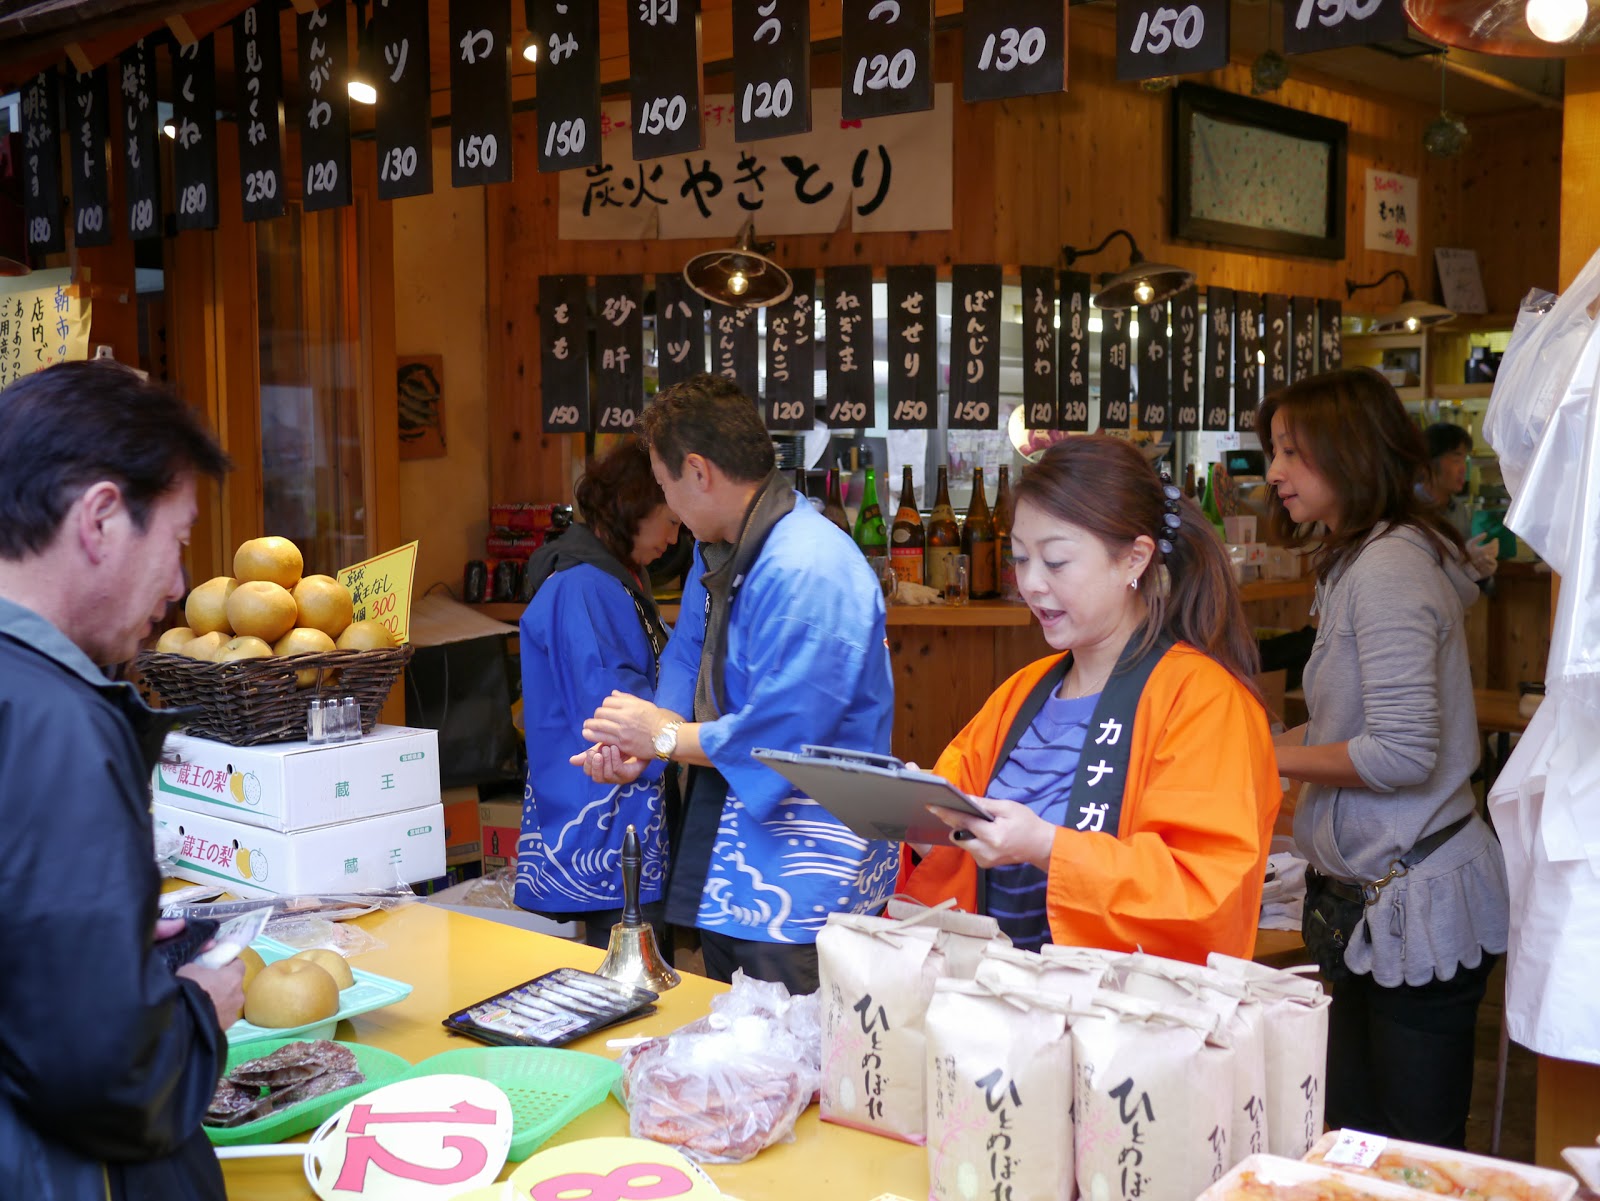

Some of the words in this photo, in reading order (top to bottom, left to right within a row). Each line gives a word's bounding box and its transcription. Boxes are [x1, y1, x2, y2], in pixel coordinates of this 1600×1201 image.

[1130, 4, 1204, 54] 150
[977, 26, 1046, 71] 130
[244, 7, 267, 146] 月見つくね
[852, 48, 916, 95] 120
[638, 95, 687, 135] 150
[741, 78, 793, 123] 120
[458, 134, 497, 168] 150
[545, 118, 586, 157] 150
[307, 160, 338, 195] 120
[381, 146, 417, 182] 130
[582, 143, 892, 218] 炭火やきとり
[180, 183, 207, 214] 180
[246, 169, 277, 203] 230
[30, 217, 51, 243] 180
[78, 205, 103, 234] 100
[131, 199, 153, 231] 180
[31, 296, 48, 362] 店内で
[553, 303, 569, 360] もも
[602, 294, 637, 374] 砂肝
[665, 301, 692, 363] ハツ
[836, 291, 861, 372] ねぎま
[901, 292, 924, 378] せせり
[964, 290, 994, 384] ぼんじり
[1034, 287, 1052, 376] えんがわ
[1069, 292, 1084, 387] 月見つくね
[719, 315, 737, 381] なんこつ
[773, 317, 790, 381] なんこつ
[1272, 318, 1284, 381] つくね
[549, 405, 579, 424] 150
[600, 407, 636, 428] 130
[773, 401, 805, 420] 120
[829, 401, 867, 422] 150
[893, 400, 928, 421] 150
[954, 402, 990, 422] 150
[1031, 402, 1052, 424] 120
[1064, 401, 1087, 422] 230
[1106, 400, 1128, 422] 150
[1144, 405, 1165, 424] 150
[1178, 407, 1196, 425] 100
[1208, 407, 1227, 427] 130
[372, 592, 396, 620] 300
[379, 615, 398, 633] 00
[177, 763, 228, 793] 蔵王の梨
[1076, 718, 1122, 832] カナガ
[180, 834, 234, 868] 蔵王の梨
[853, 993, 889, 1120] ひとめぼれ
[332, 1101, 497, 1193] 12
[975, 1068, 1023, 1201] ひとめぼれ
